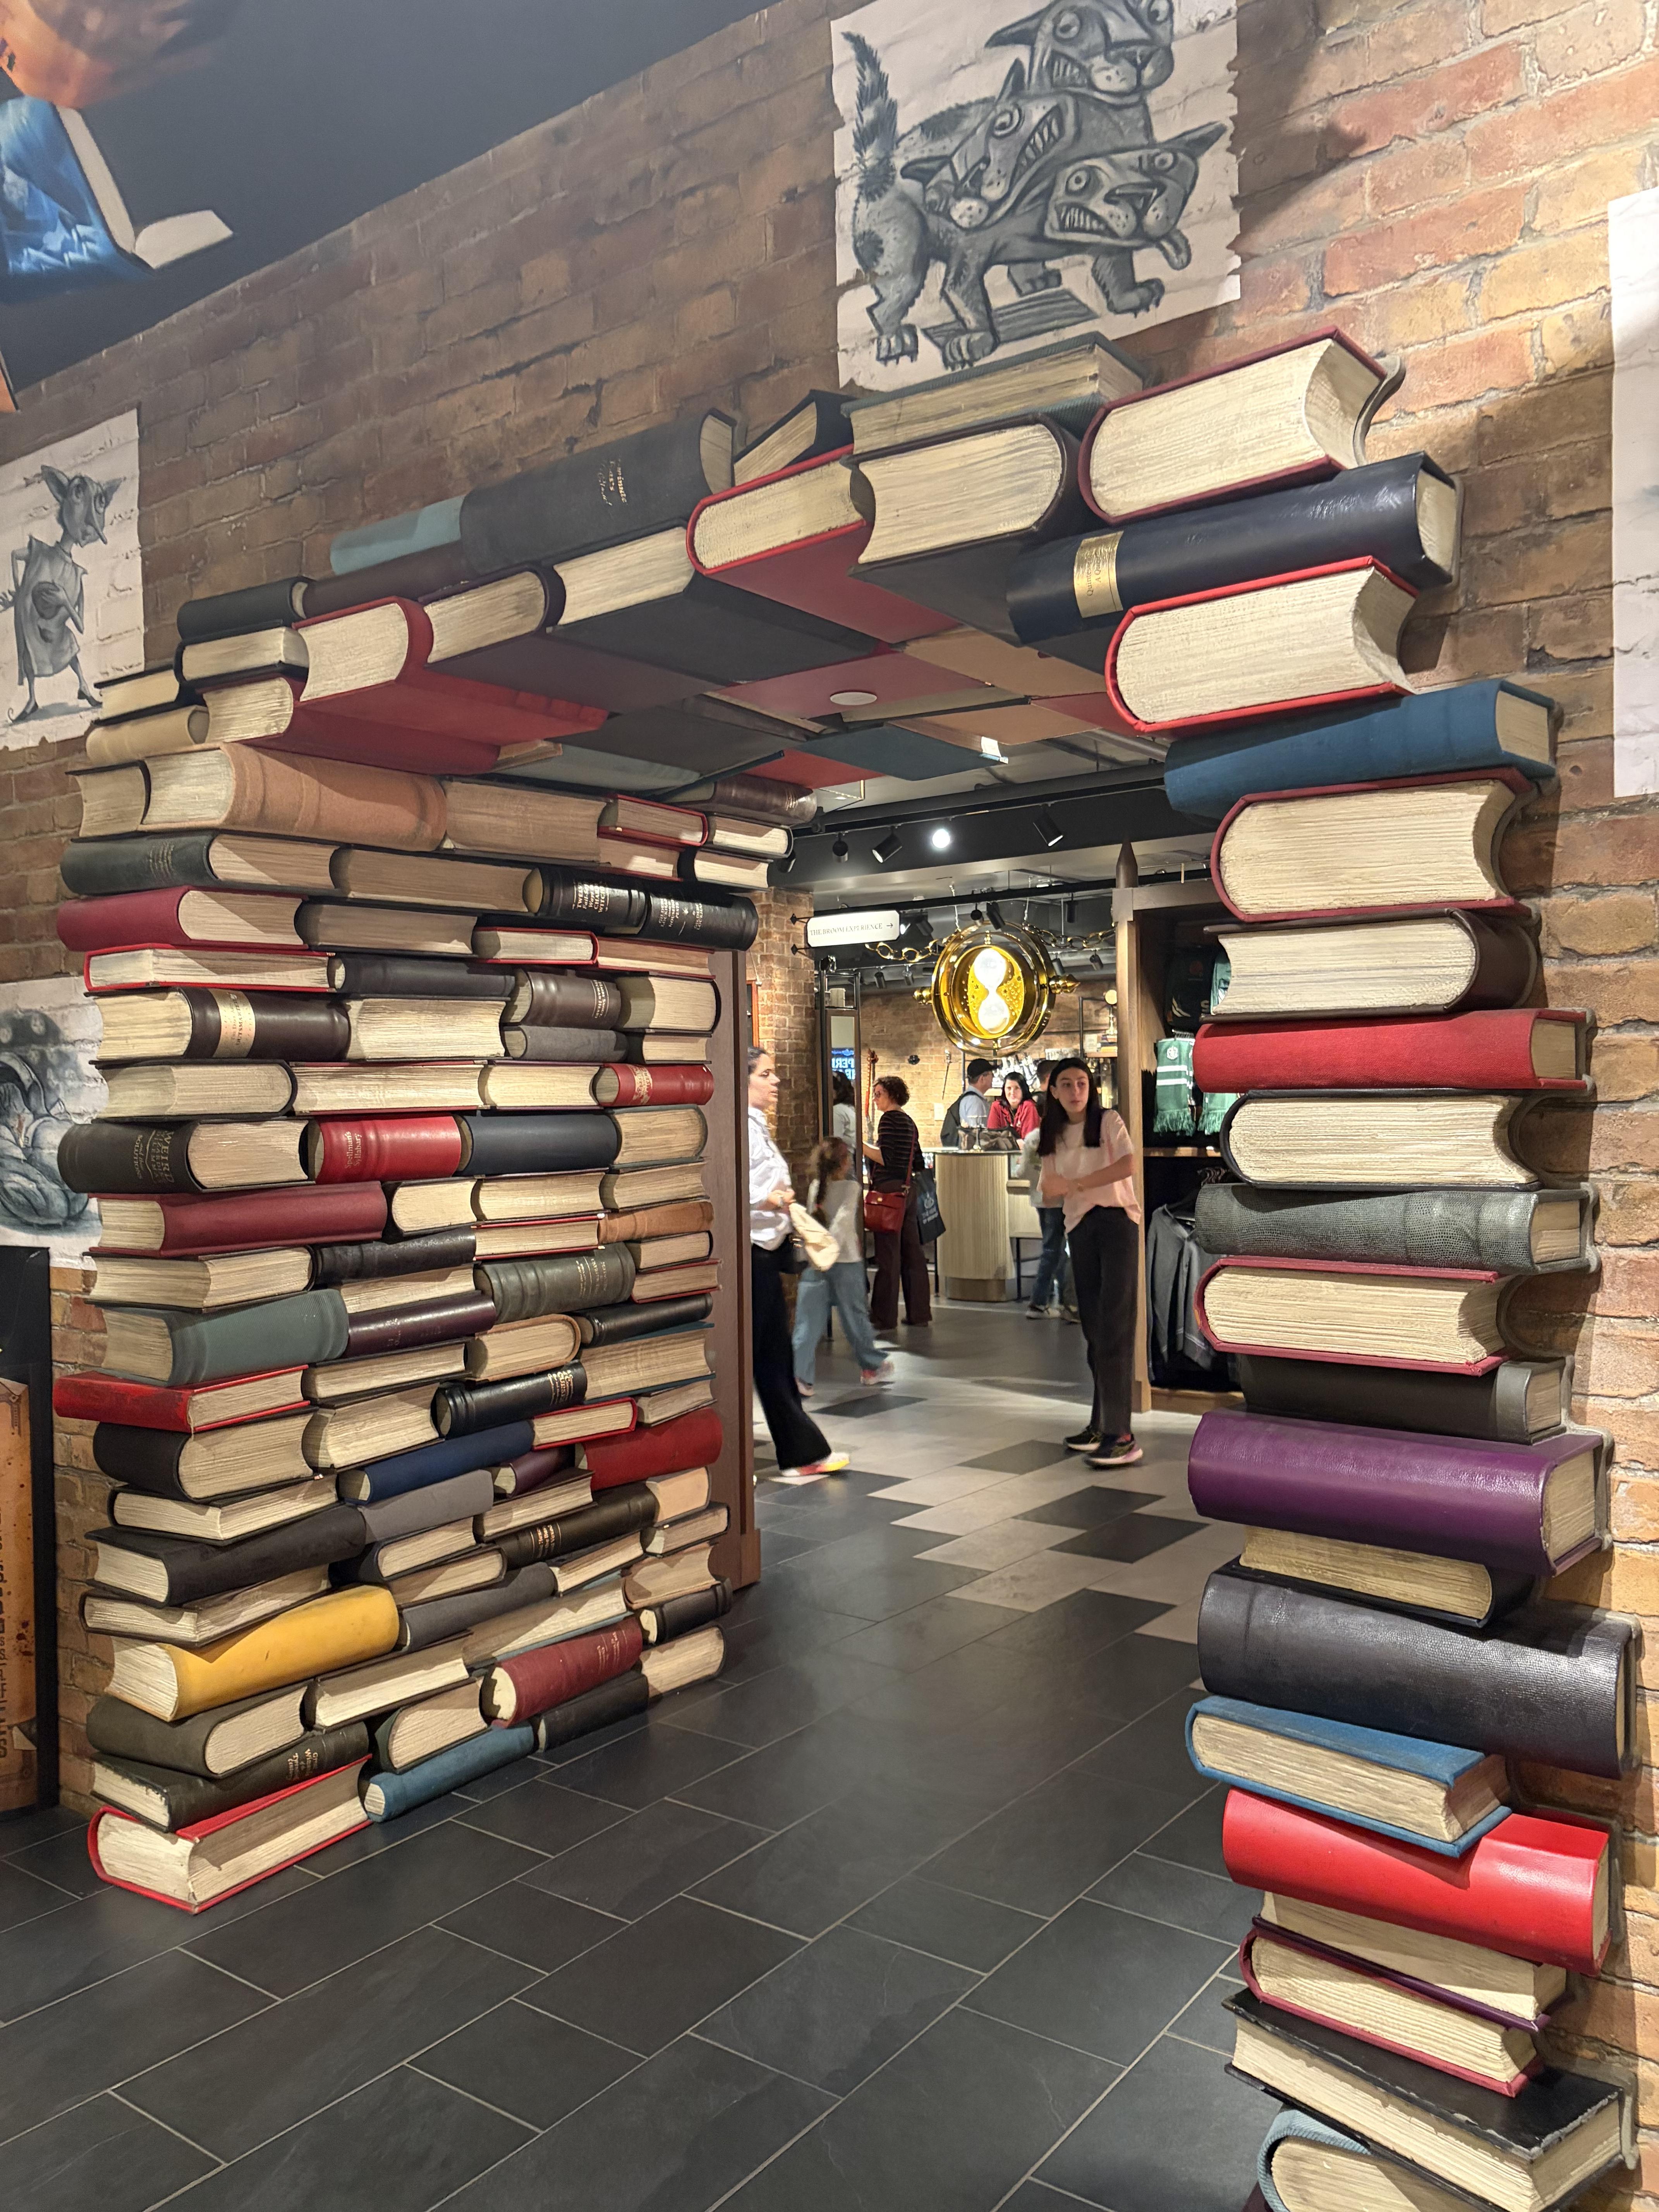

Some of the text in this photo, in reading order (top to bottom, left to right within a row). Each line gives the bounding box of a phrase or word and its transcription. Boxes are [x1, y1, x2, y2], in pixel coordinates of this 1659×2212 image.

[845, 923, 883, 932] EXPERIENCE
[151, 1132, 161, 1181] DILEMMA
[161, 1131, 174, 1183] WEIRD
[344, 1131, 353, 1168] Spellman's
[353, 1133, 362, 1166] Syllabary
